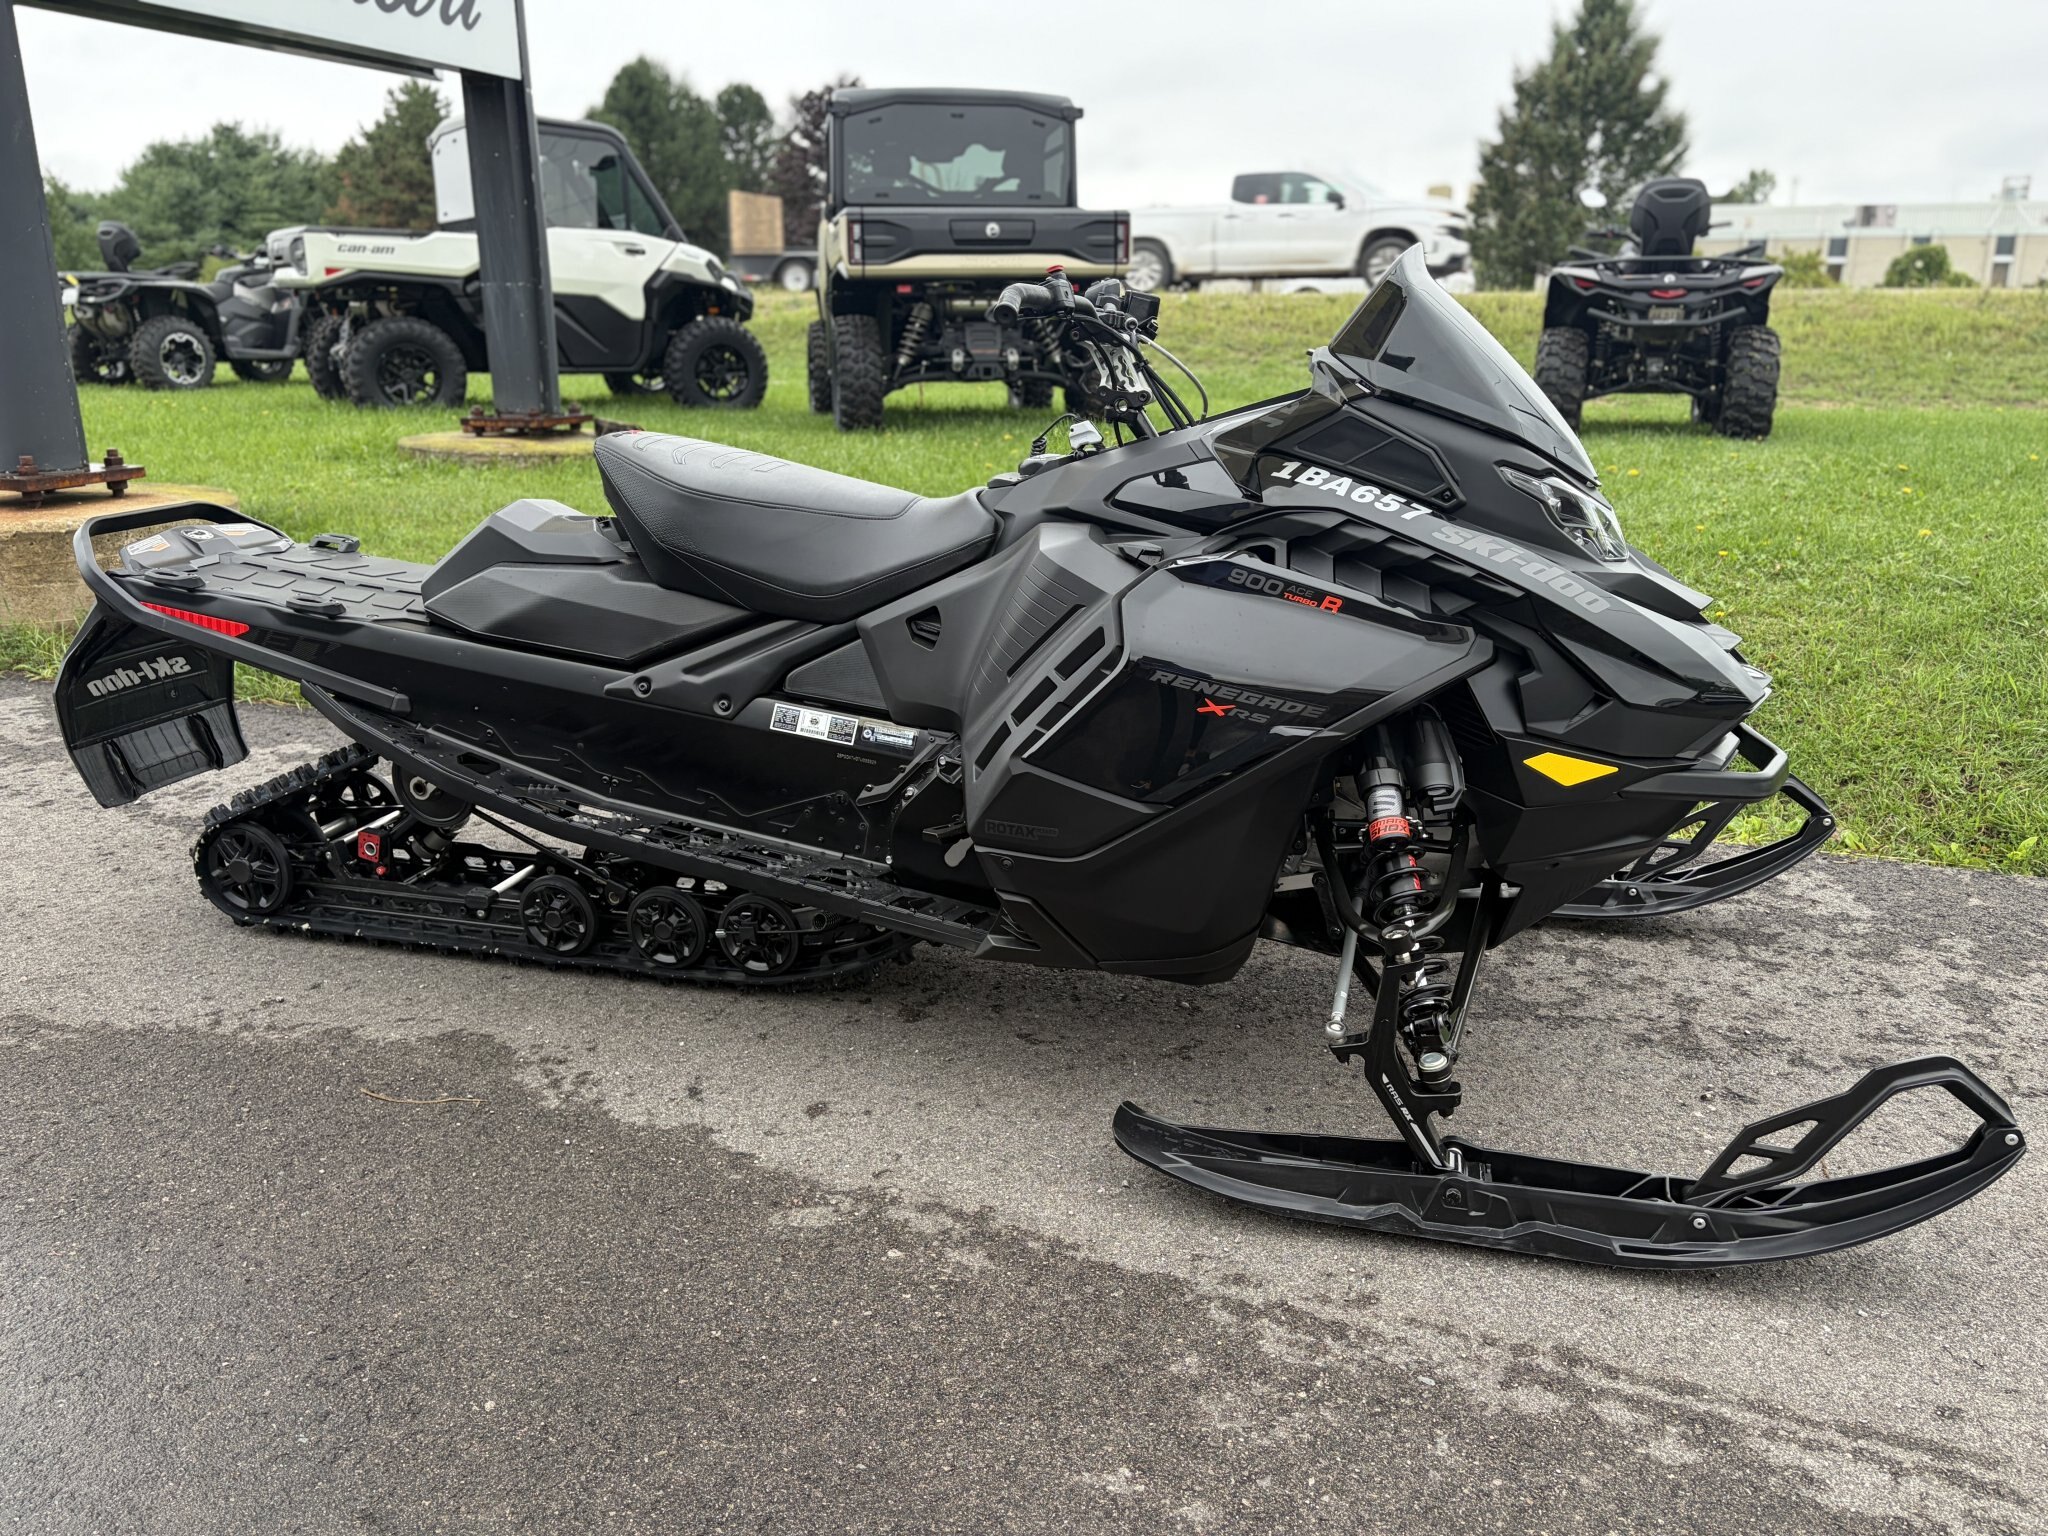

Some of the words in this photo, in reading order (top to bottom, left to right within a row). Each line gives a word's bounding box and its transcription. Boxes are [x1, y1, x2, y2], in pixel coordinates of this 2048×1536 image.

[1271, 461, 1433, 520] 1BA657
[1228, 568, 1284, 595] 900
[1288, 584, 1315, 598] ACE
[1284, 592, 1318, 607] TURBO
[1320, 595, 1343, 615] R
[1149, 670, 1329, 718] RENEGADE
[987, 822, 1036, 839] ROTAX
